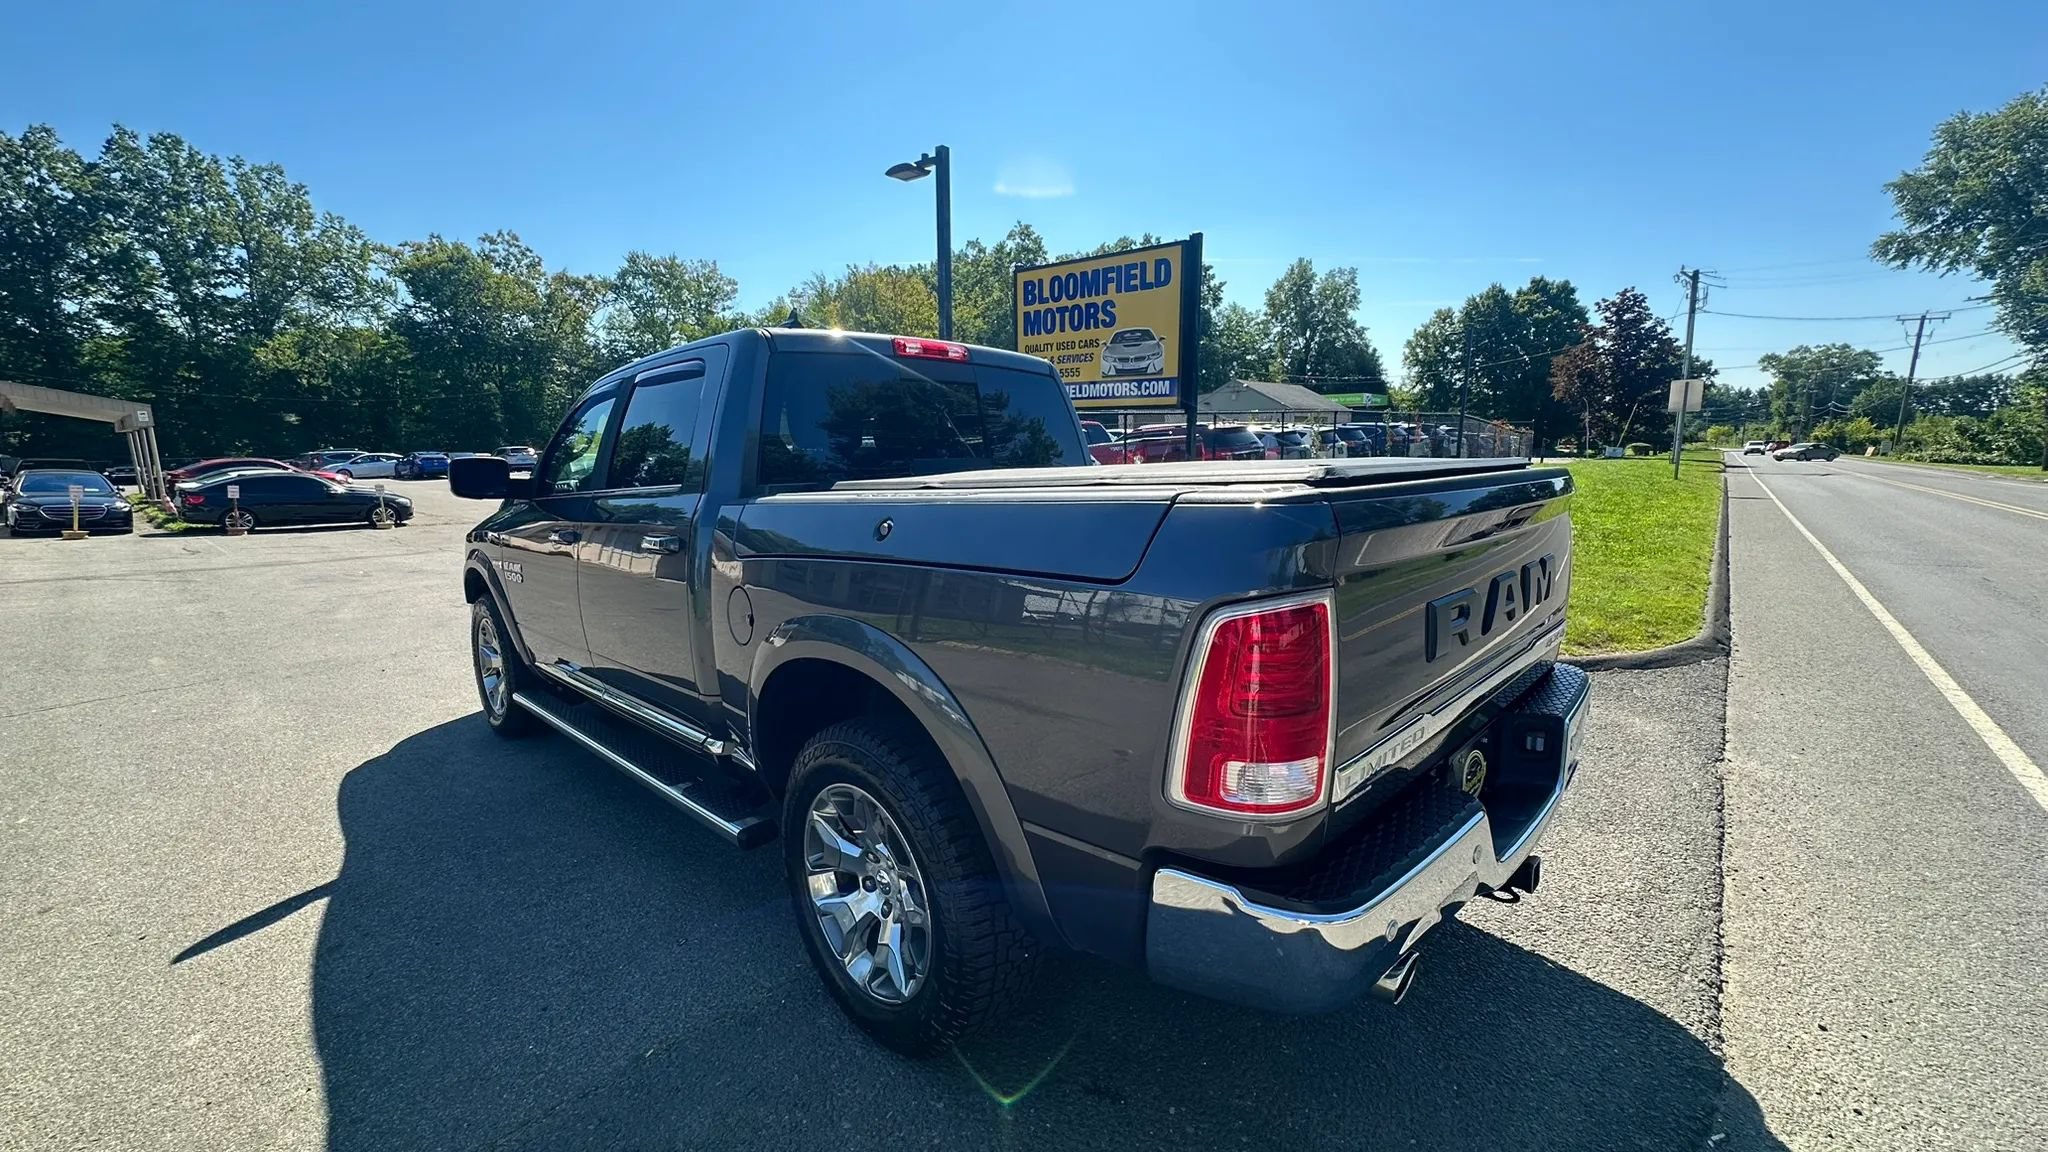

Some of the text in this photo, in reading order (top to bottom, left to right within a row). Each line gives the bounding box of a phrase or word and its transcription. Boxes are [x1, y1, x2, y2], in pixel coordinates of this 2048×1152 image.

[1023, 258, 1171, 306] BLOOMFIELD
[1023, 300, 1116, 336] MOTORS
[1025, 338, 1100, 354] QUALITY USED CARS
[1056, 353, 1094, 364] SERVICES
[1065, 381, 1170, 398] IELDMOTORS.COM
[1425, 553, 1556, 663] RAM
[1344, 727, 1425, 789] LIMITED
